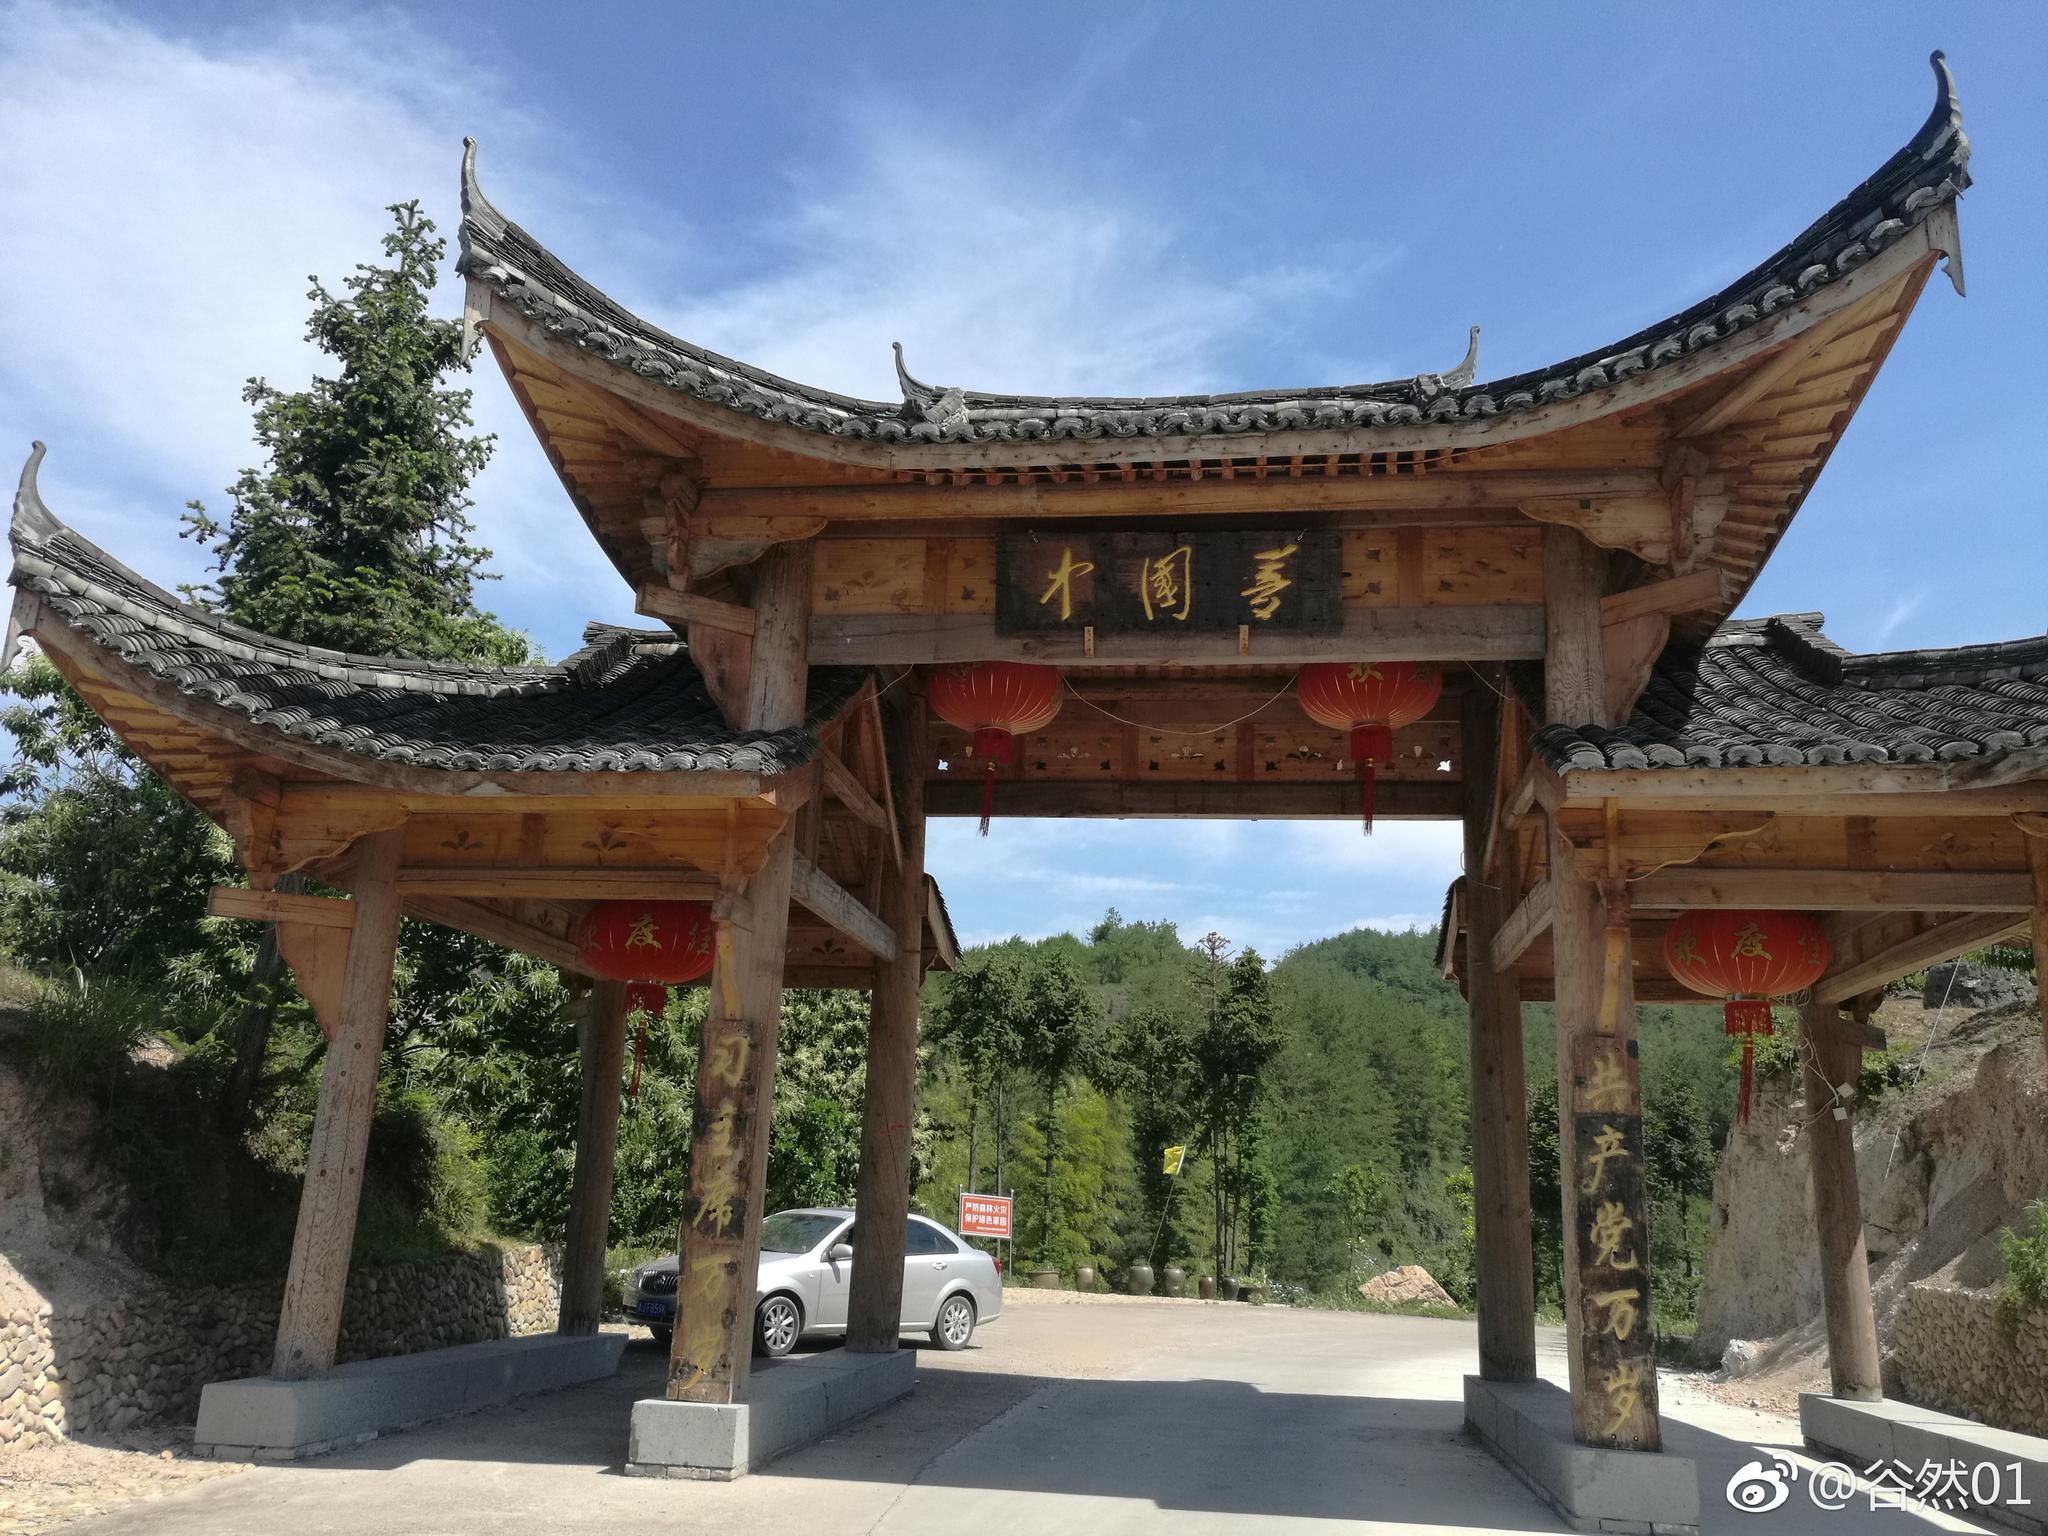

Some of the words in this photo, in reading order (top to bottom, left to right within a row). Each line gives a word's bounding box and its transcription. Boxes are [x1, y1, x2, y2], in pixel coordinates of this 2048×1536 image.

[965, 1202, 1008, 1215] 严防森林火灾
[965, 1213, 1007, 1226] 保护绿色家园
[1581, 1050, 1641, 1434] 共产党万岁
